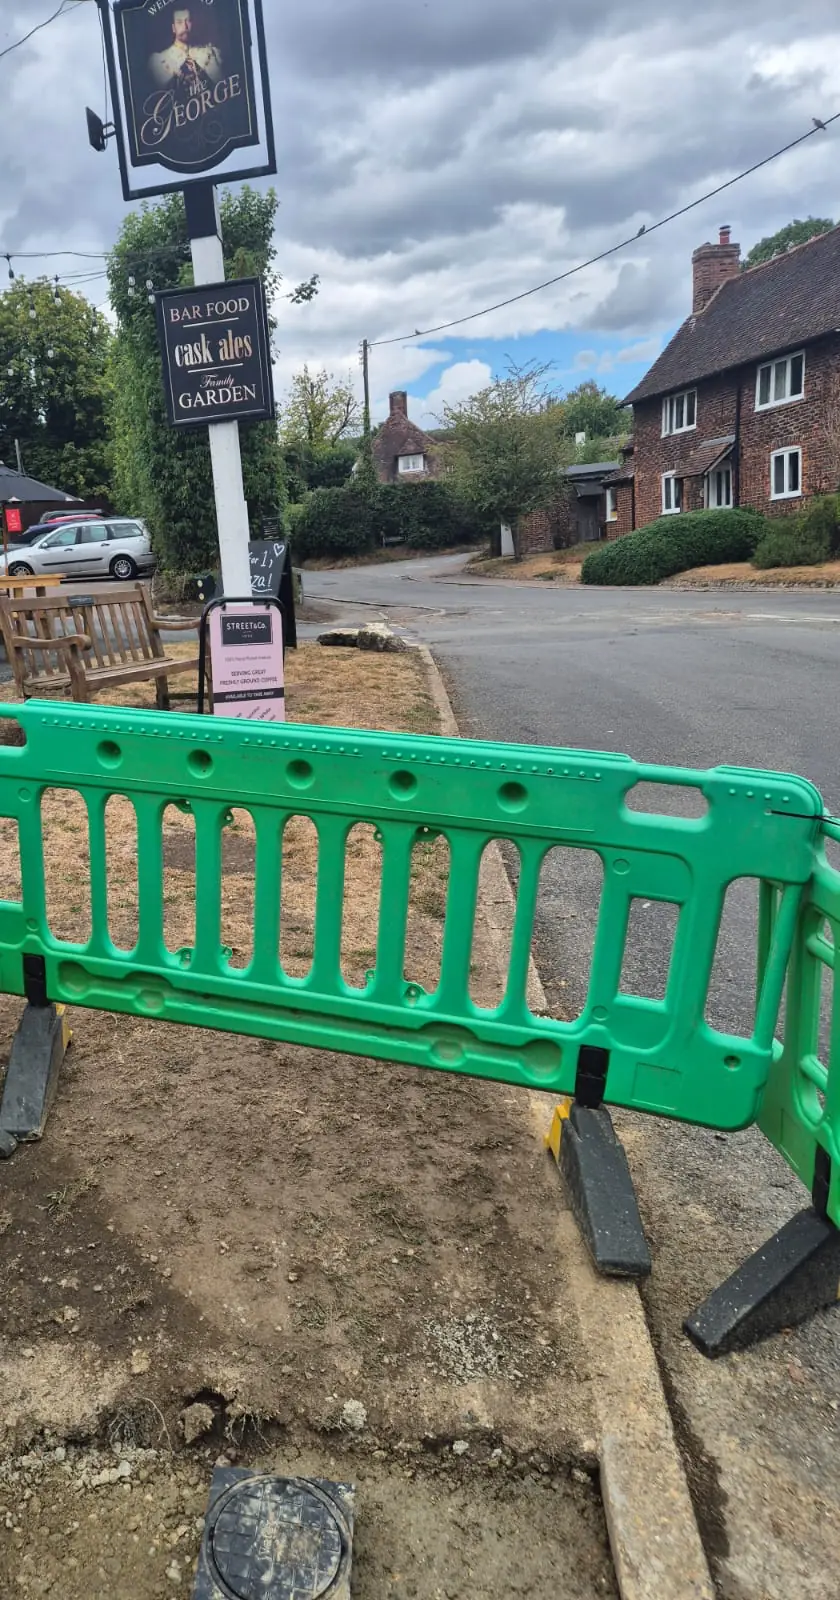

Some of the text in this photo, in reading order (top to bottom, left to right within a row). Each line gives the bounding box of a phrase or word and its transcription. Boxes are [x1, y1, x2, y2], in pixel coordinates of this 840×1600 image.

[188, 78, 208, 97] the
[169, 297, 250, 322] BAR FOOD
[174, 329, 253, 367] cask ales
[199, 373, 235, 388] Family
[178, 383, 257, 409] GARDEN
